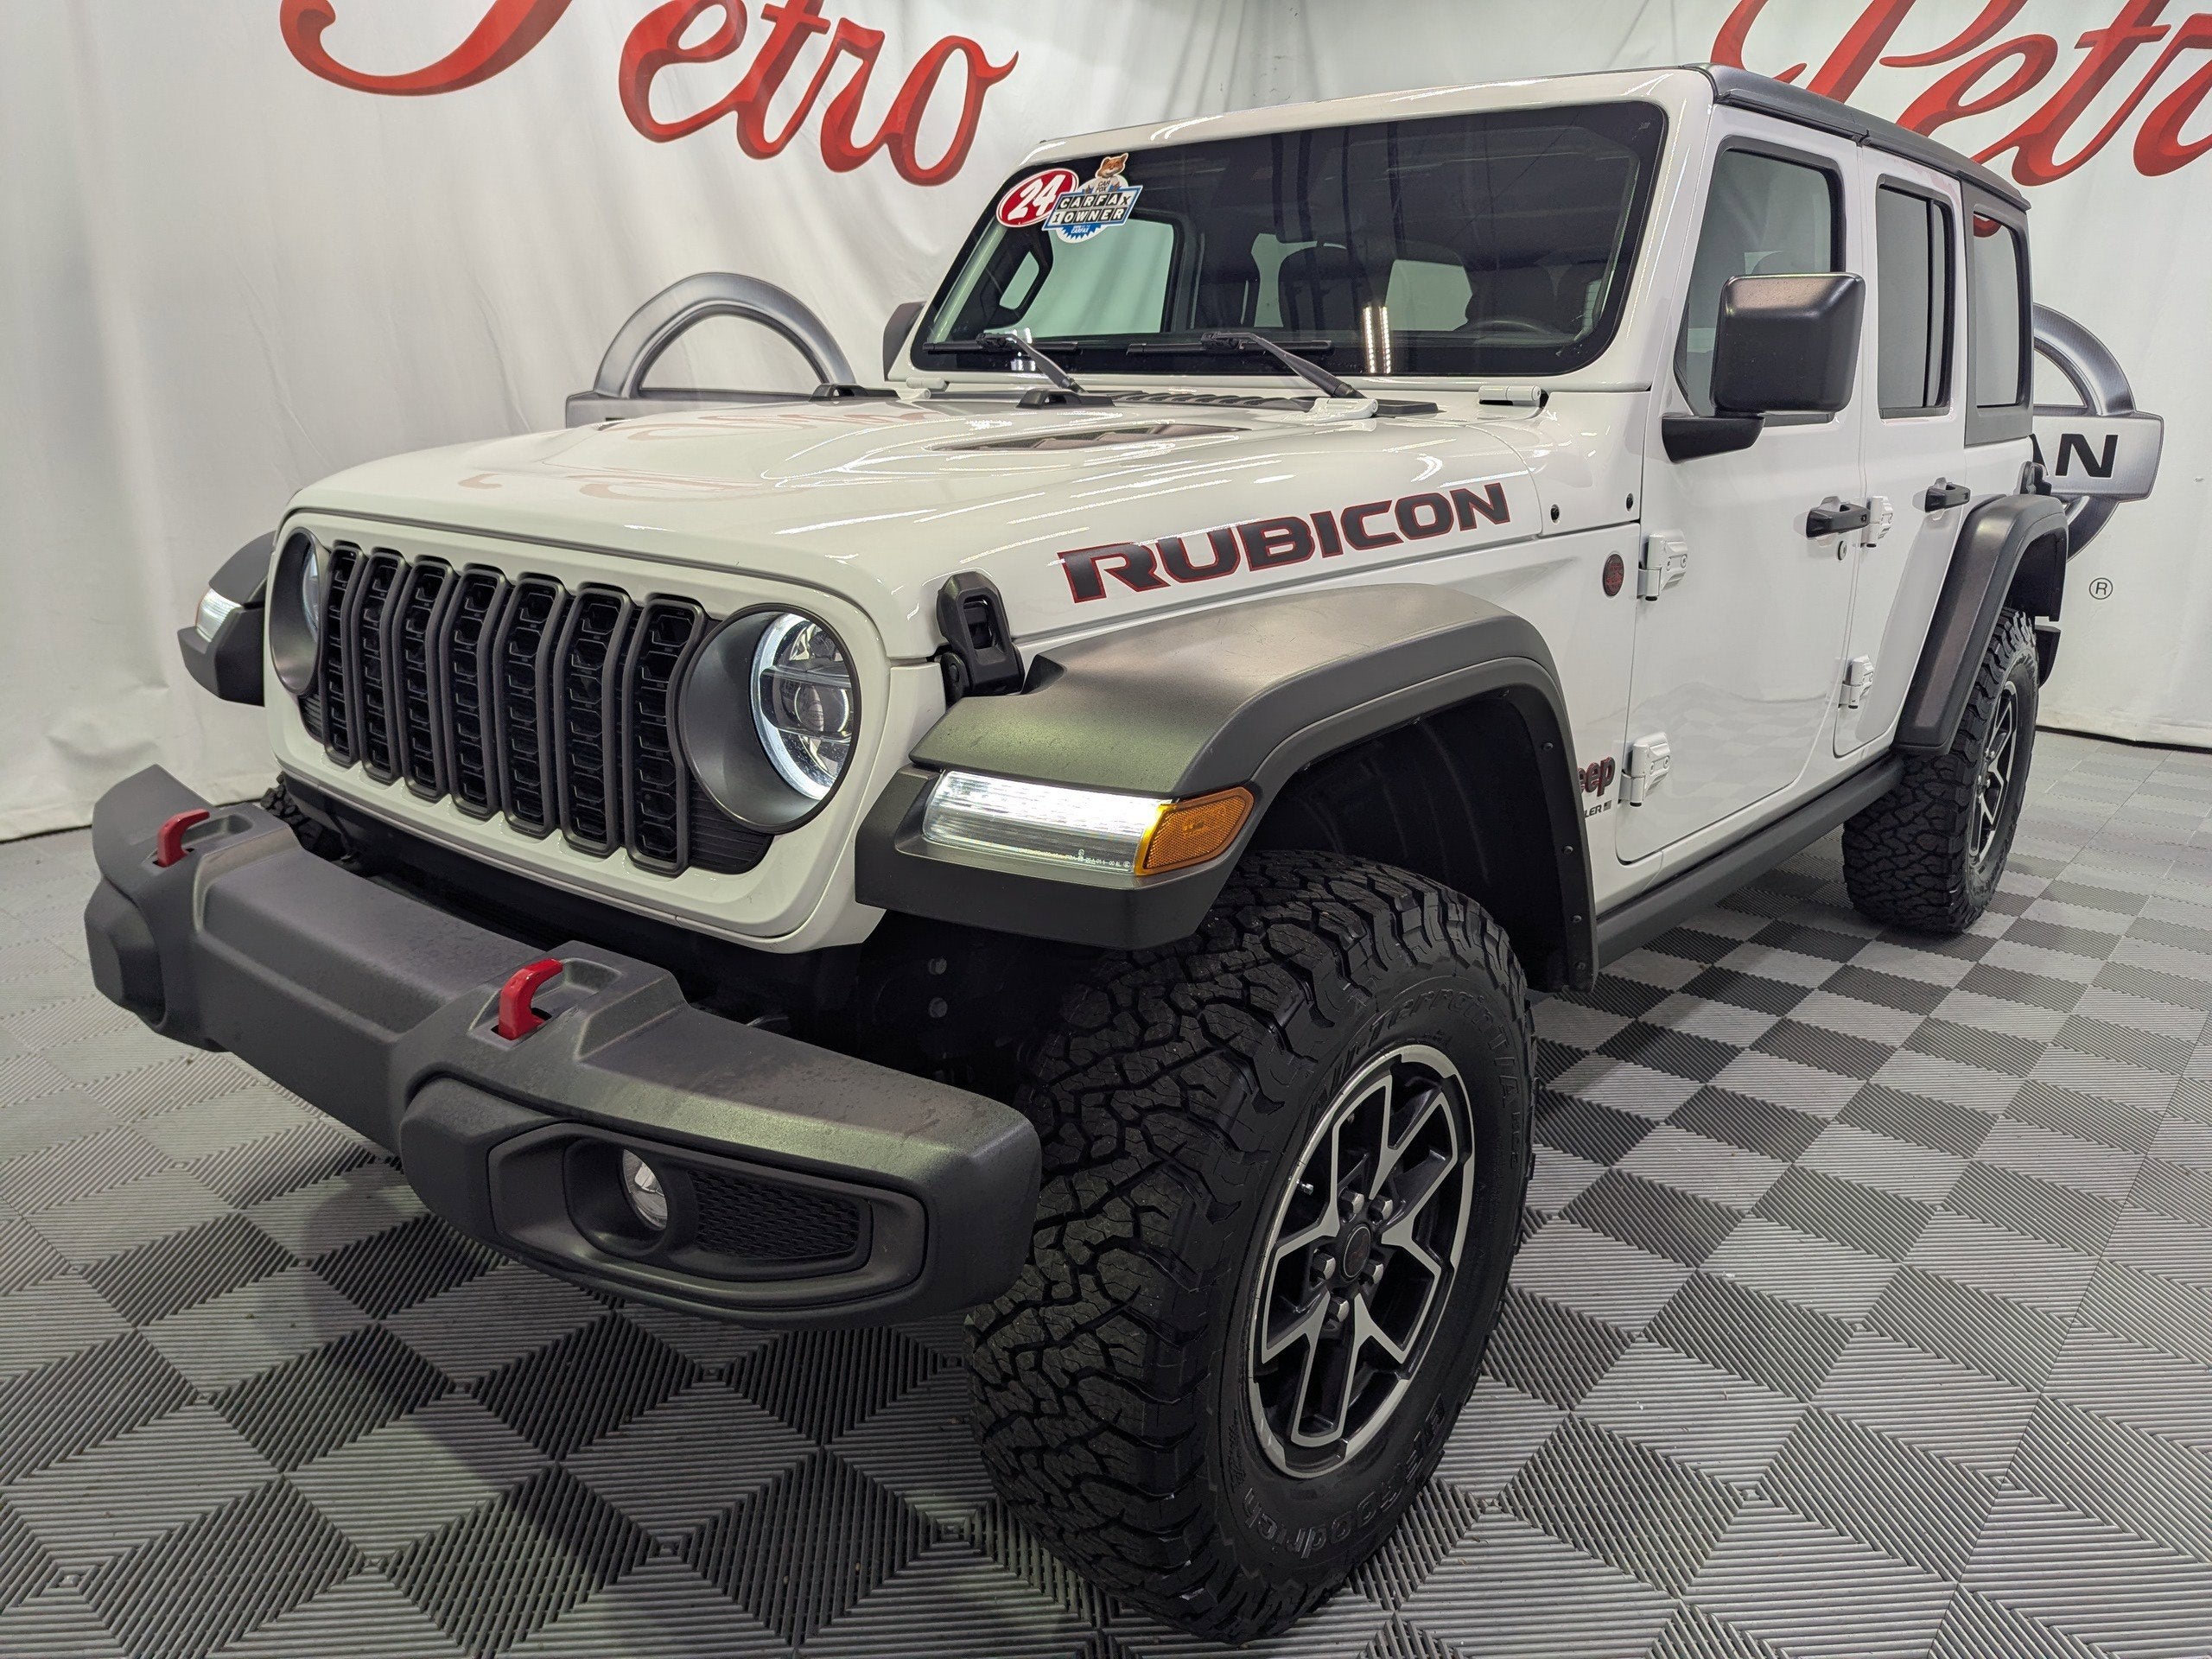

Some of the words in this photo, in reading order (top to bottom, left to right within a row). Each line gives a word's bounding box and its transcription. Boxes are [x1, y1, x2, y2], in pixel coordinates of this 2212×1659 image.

[1007, 174, 1066, 220] 24
[1059, 194, 1132, 208] CARFAX
[1052, 213, 1062, 223] 1
[1063, 208, 1125, 223] OWNER
[1057, 482, 1511, 603] RUBICON
